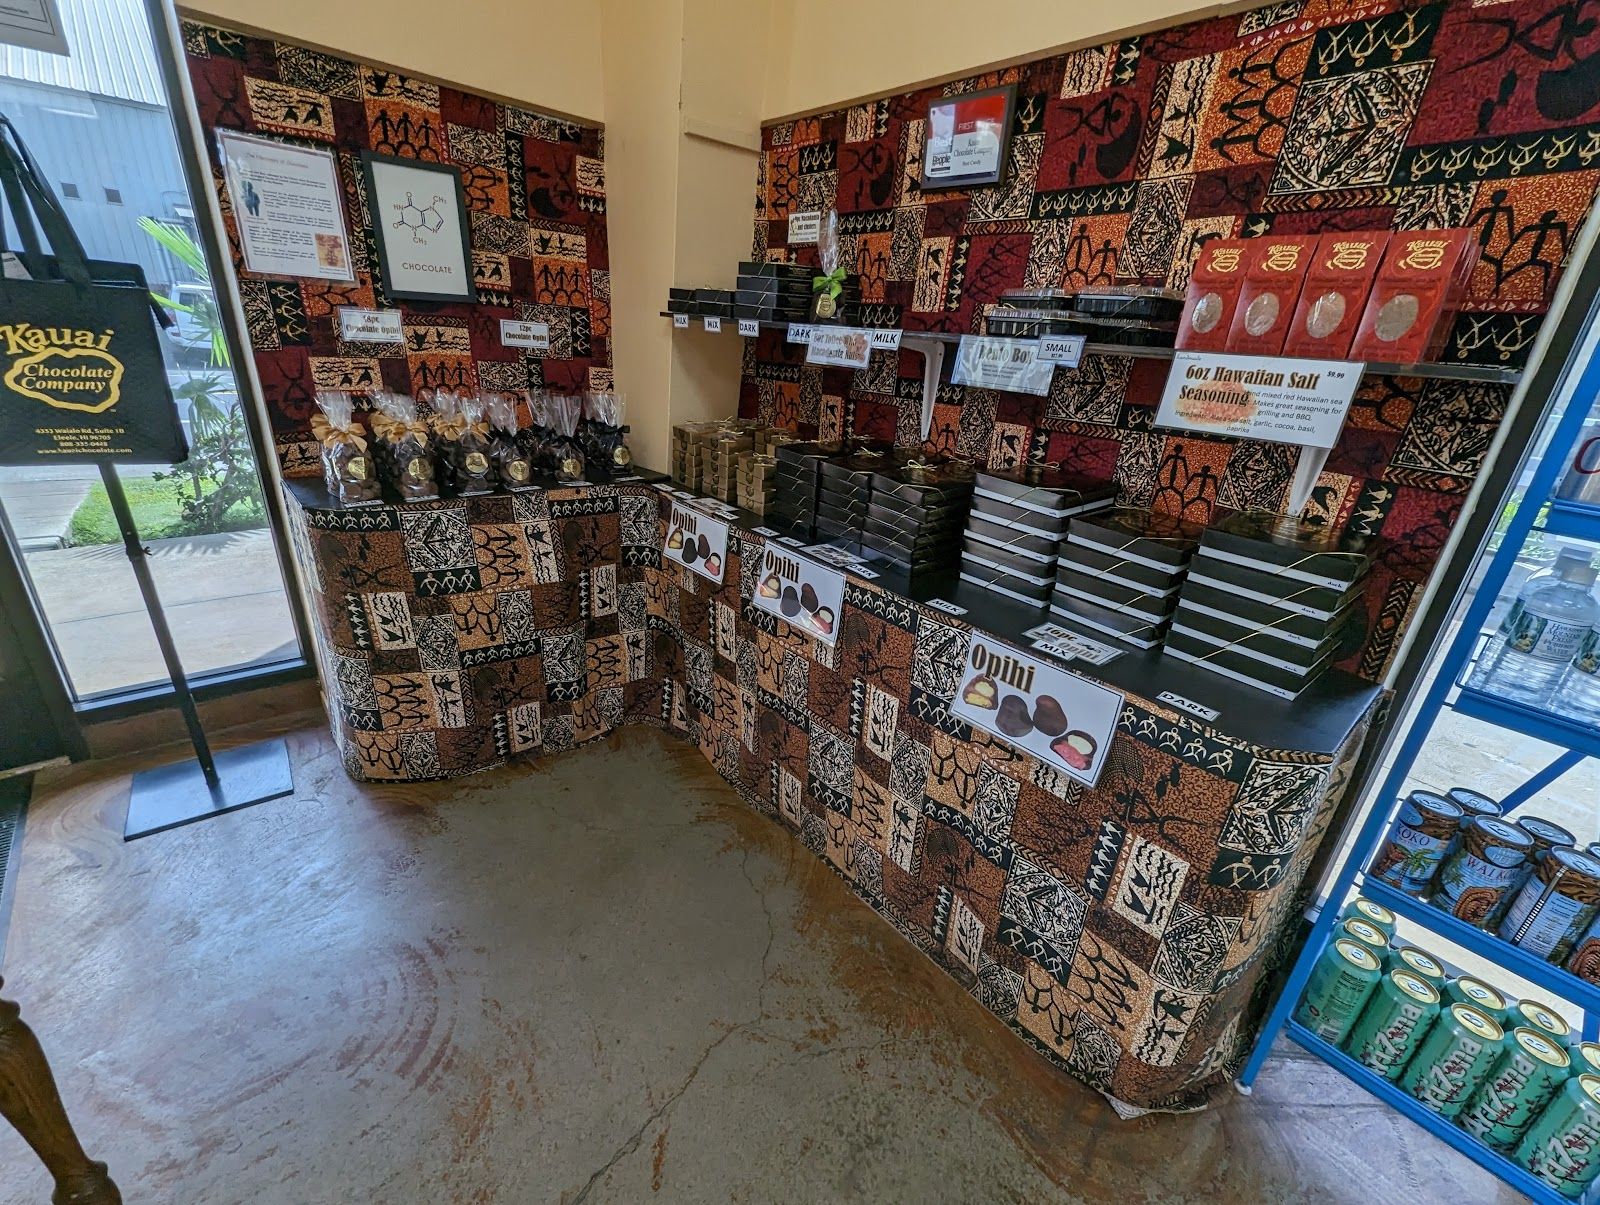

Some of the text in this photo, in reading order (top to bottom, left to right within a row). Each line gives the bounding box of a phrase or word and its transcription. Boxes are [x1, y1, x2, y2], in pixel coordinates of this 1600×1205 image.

[1406, 239, 1452, 252] Kauai
[401, 262, 453, 274] CHOCOLATE
[739, 322, 757, 333] DARK
[788, 327, 811, 339] DARK
[0, 323, 115, 355] Kauai
[873, 332, 897, 344] MILK
[1045, 343, 1072, 353] SMALL
[1011, 347, 1034, 364] Box
[23, 363, 113, 379] Chocolate
[1185, 364, 1320, 390] 6oz Hawaiian Salt
[1326, 370, 1345, 379] $9.99
[21, 376, 106, 393] Company
[1178, 384, 1250, 408] Seasoning
[1261, 391, 1282, 400] mixed
[1296, 395, 1329, 404] Hawaiian
[1252, 399, 1343, 415] Makes great seasoning for
[1256, 409, 1280, 419] grilling
[1281, 411, 1294, 419] and
[672, 507, 697, 535] Opihi
[765, 549, 800, 584] Opihi
[849, 563, 876, 577] DARK
[932, 600, 960, 612] MILK
[1040, 643, 1070, 657] MIX
[970, 643, 1037, 695] Opihi
[1162, 693, 1210, 716] DARK
